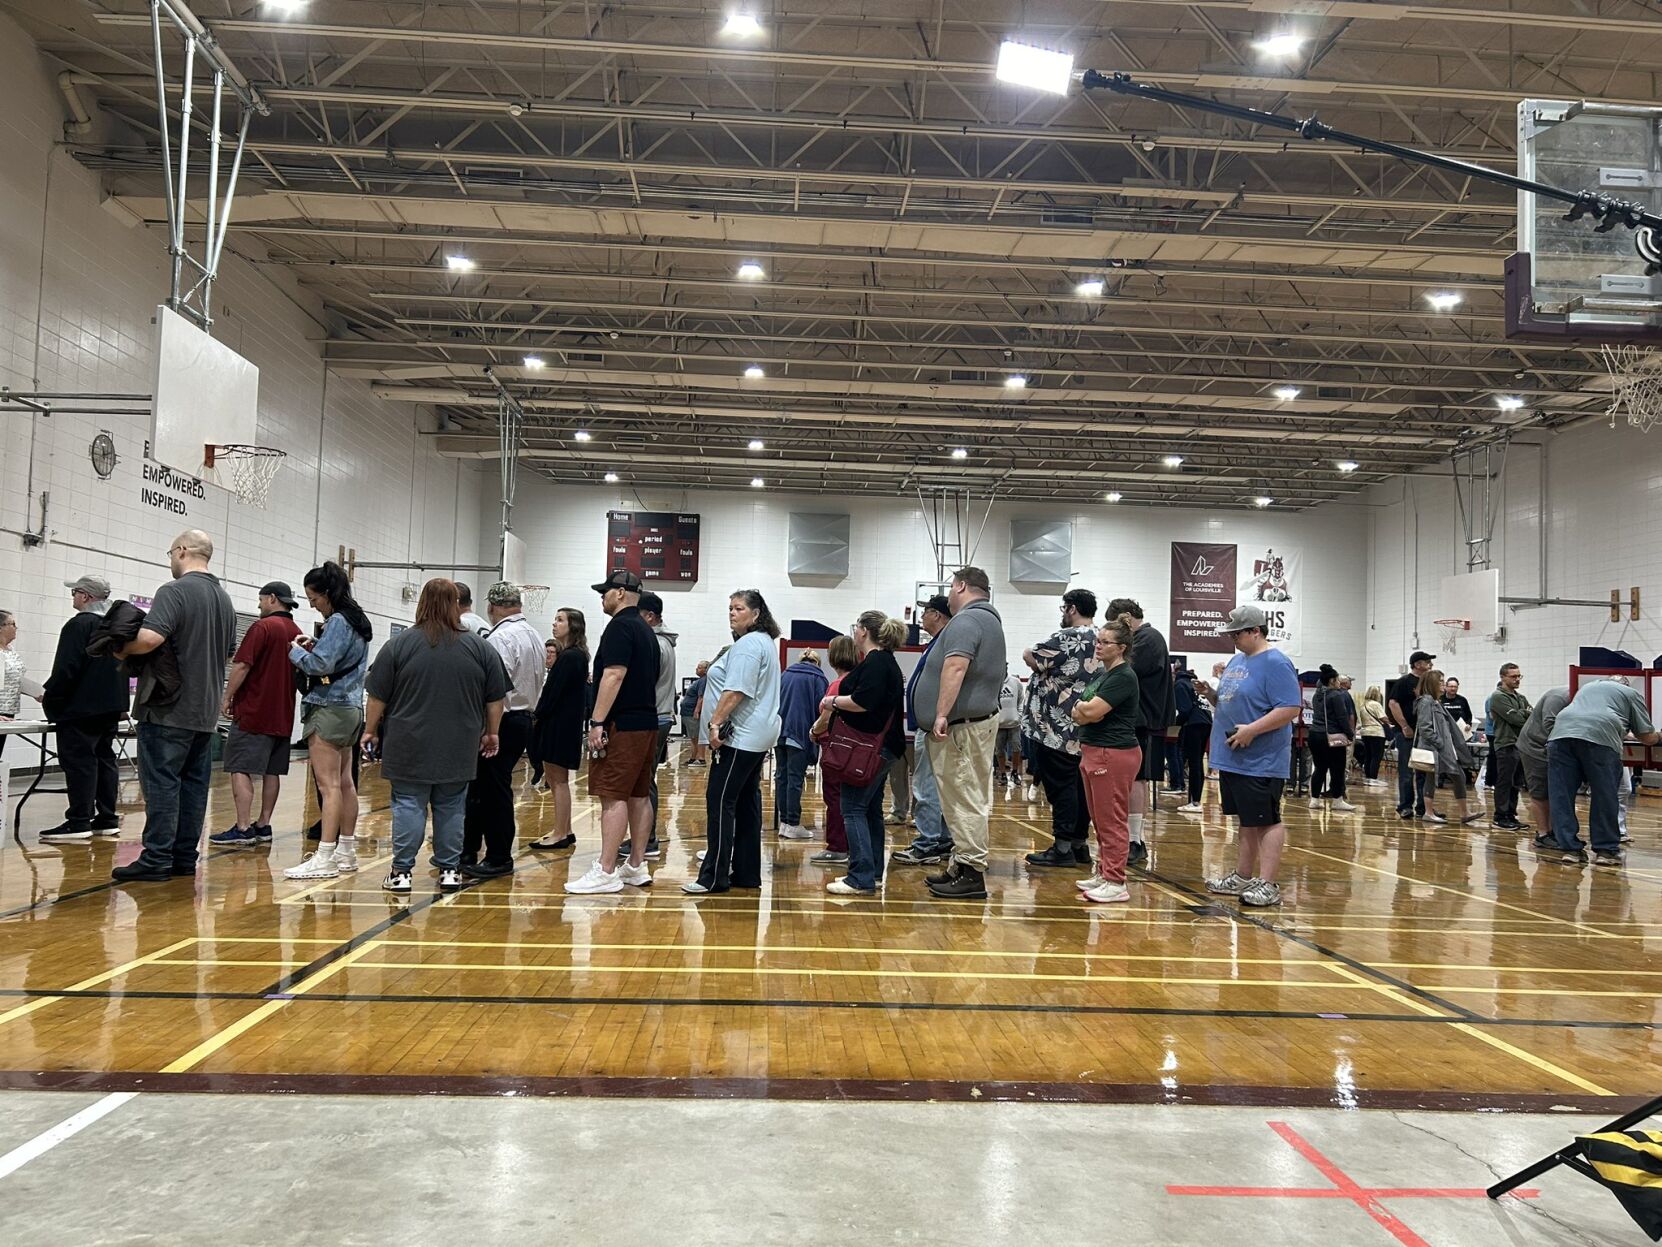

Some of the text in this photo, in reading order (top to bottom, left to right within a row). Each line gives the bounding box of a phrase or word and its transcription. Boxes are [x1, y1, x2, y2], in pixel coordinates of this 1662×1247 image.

[143, 464, 206, 500] EMPOWERED.
[141, 488, 188, 516] INSPIRED.
[1182, 610, 1223, 618] PREPARED.
[1262, 610, 1285, 629] HS
[1183, 629, 1221, 637] INSPIRED.
[1269, 629, 1292, 641] GERS
